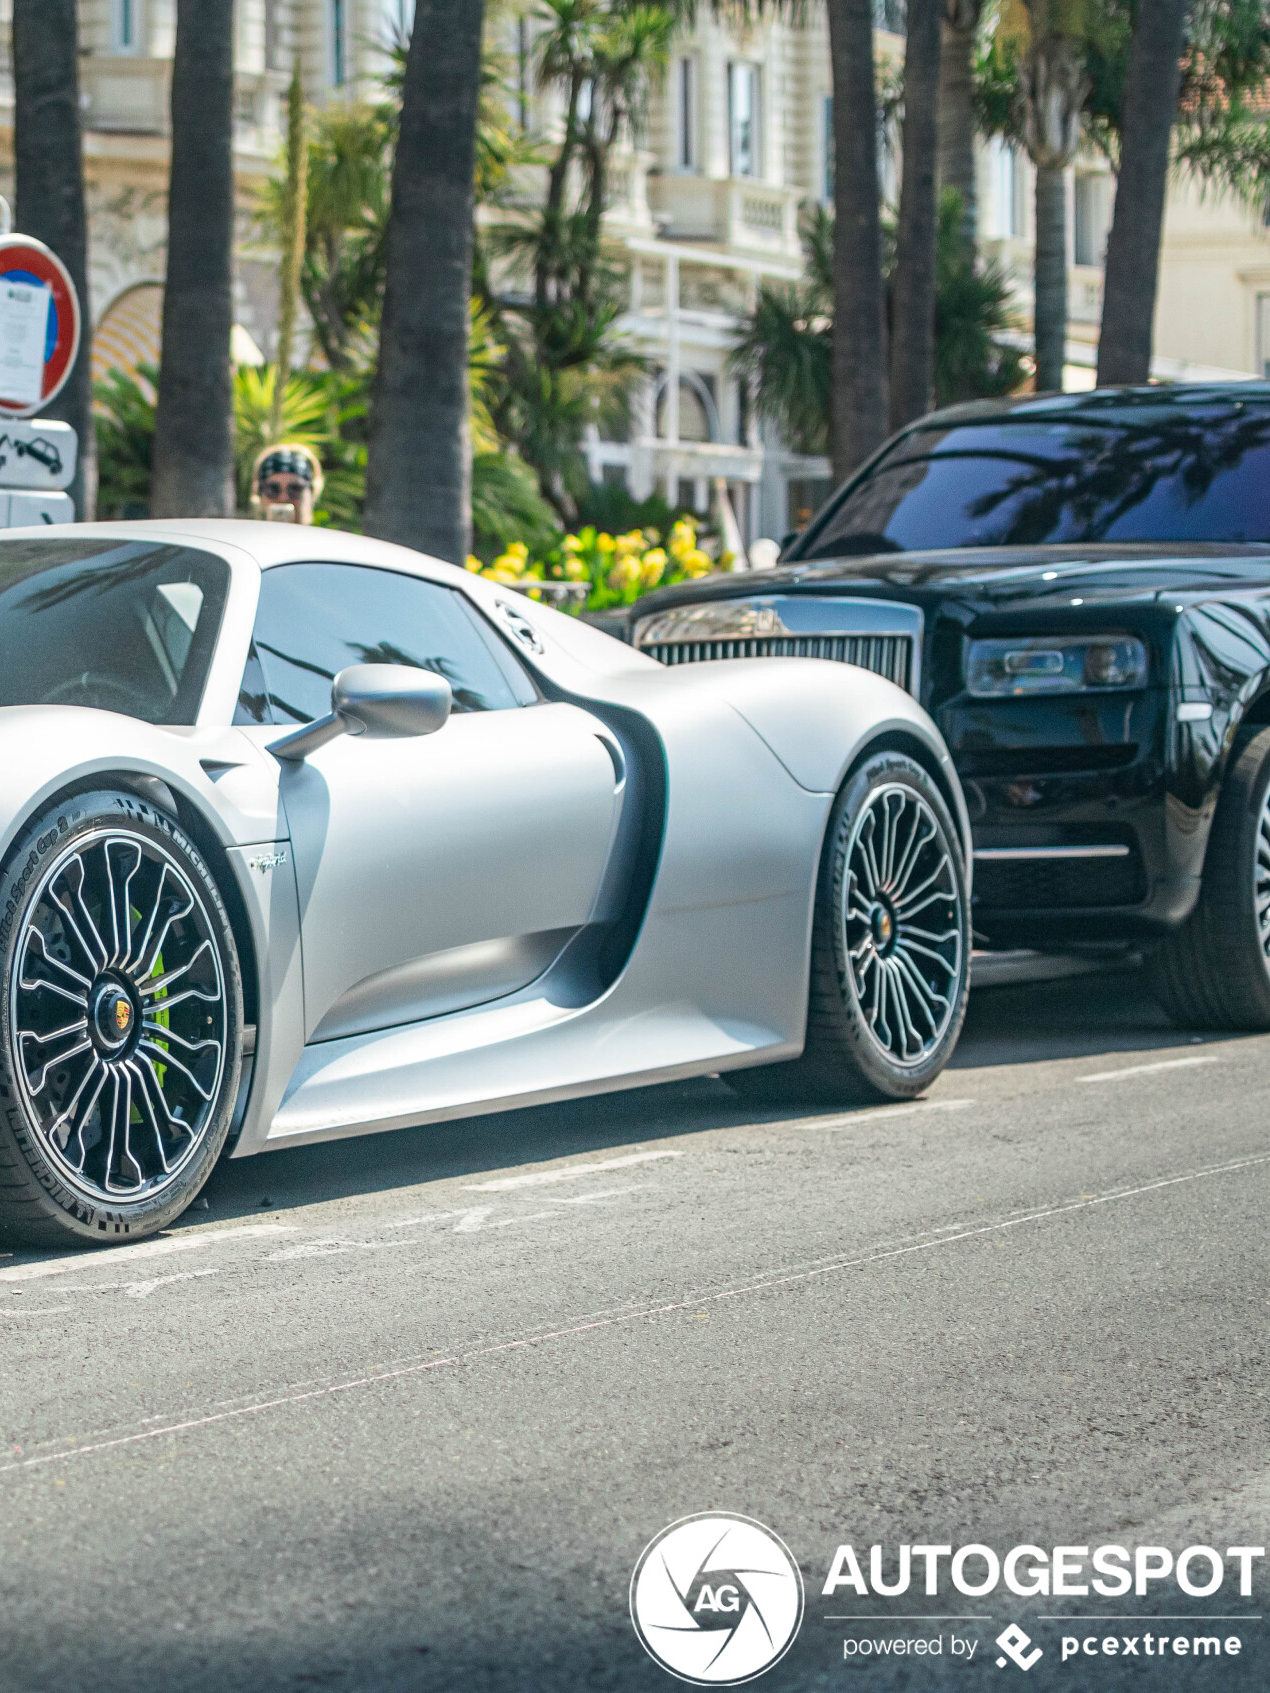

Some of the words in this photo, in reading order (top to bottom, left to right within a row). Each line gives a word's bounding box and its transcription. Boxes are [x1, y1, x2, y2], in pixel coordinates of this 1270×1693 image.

[11, 853, 40, 903] Sport
[35, 826, 61, 856] Cup
[57, 815, 69, 834] 2
[170, 827, 231, 933] MICHELIN
[6, 1107, 80, 1219] MICHELIN
